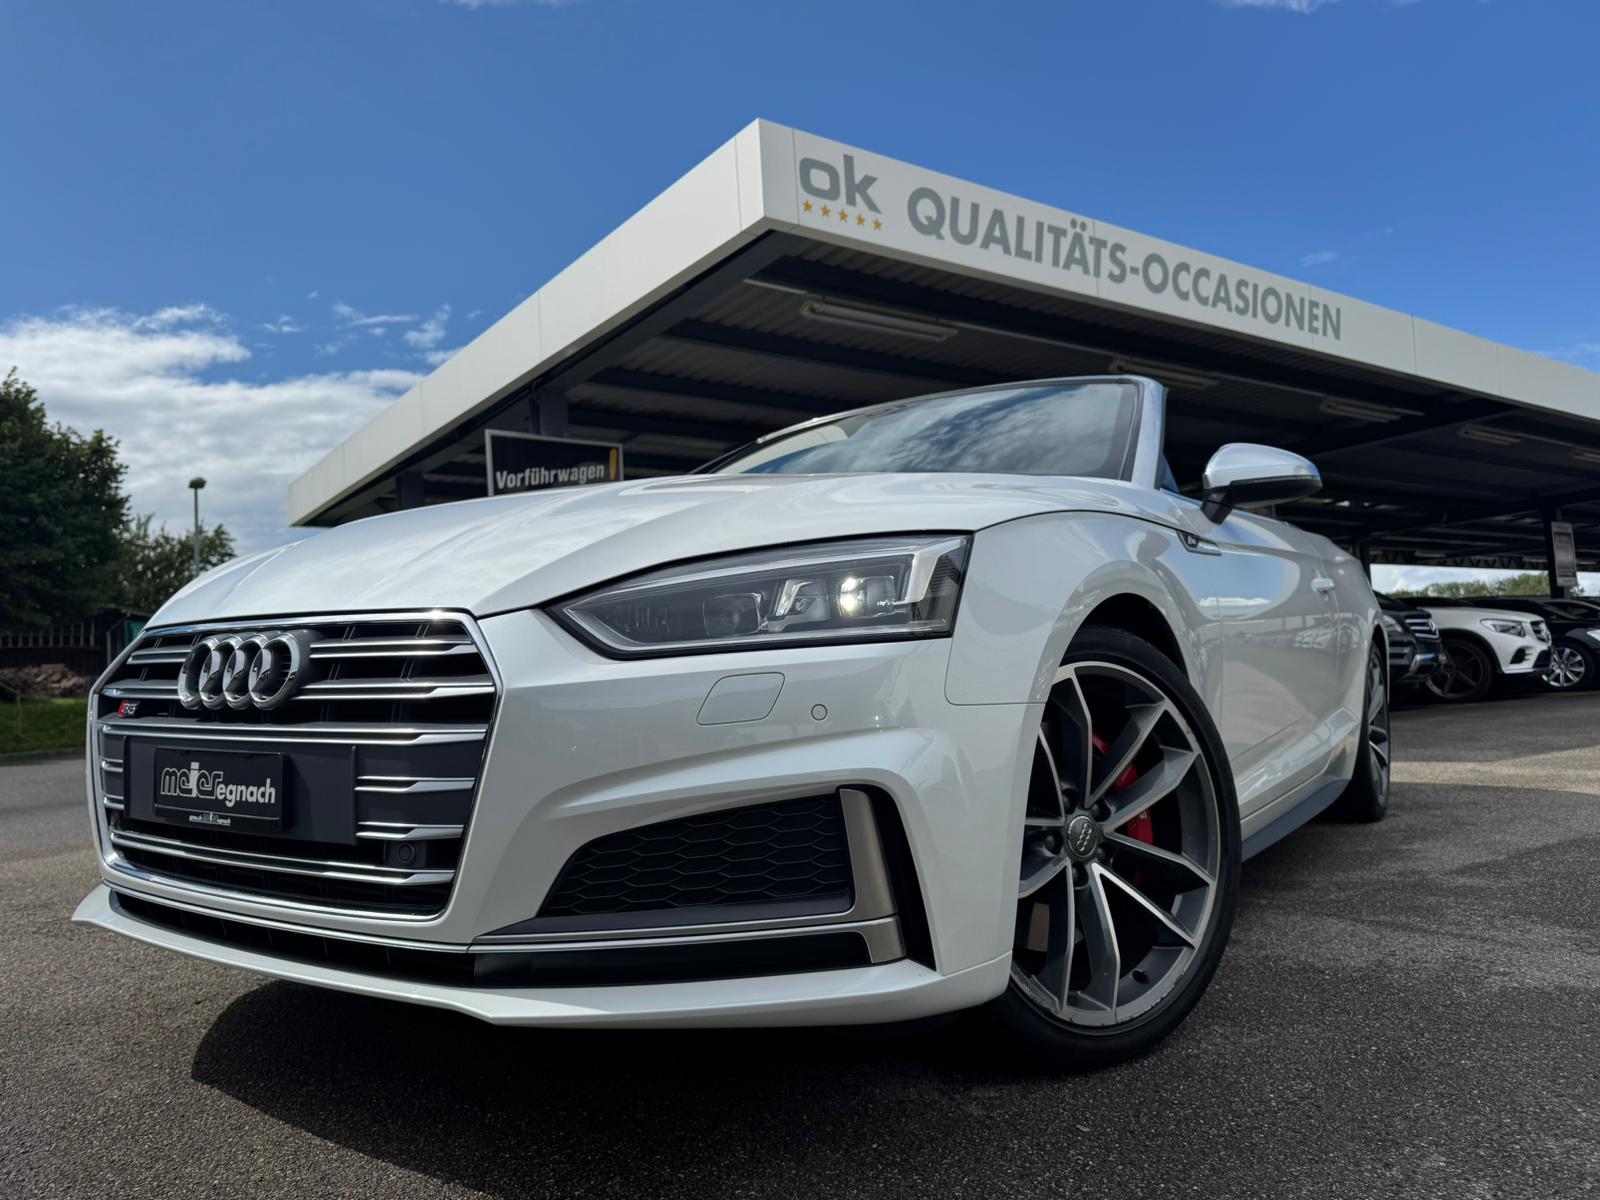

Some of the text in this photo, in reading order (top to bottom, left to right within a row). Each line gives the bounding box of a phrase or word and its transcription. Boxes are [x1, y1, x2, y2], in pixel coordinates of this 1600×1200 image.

[799, 153, 1342, 341] ok QUALITÄTS-OCCASIONEN
[496, 464, 605, 489] Vorführwagen
